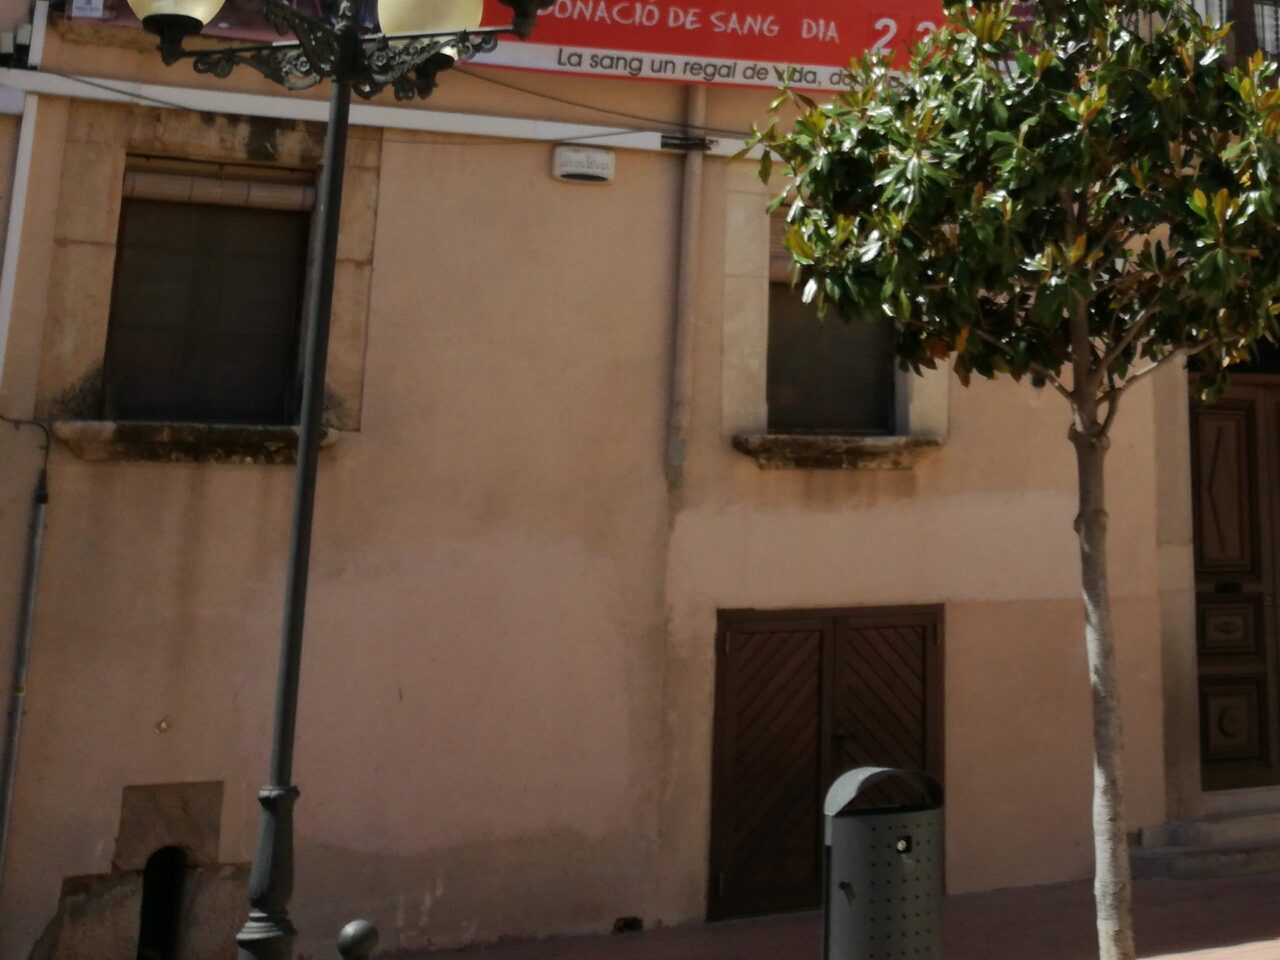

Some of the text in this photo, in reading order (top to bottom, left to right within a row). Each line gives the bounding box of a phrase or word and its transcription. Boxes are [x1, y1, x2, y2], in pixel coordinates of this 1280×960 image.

[668, 5, 701, 30] DE
[710, 11, 779, 38] SANG
[802, 18, 840, 44] DIA
[557, 48, 583, 68] La
[589, 54, 643, 76] sang
[650, 60, 676, 74] un
[683, 61, 737, 82] regal
[742, 64, 769, 81] de
[774, 64, 821, 88] da,
